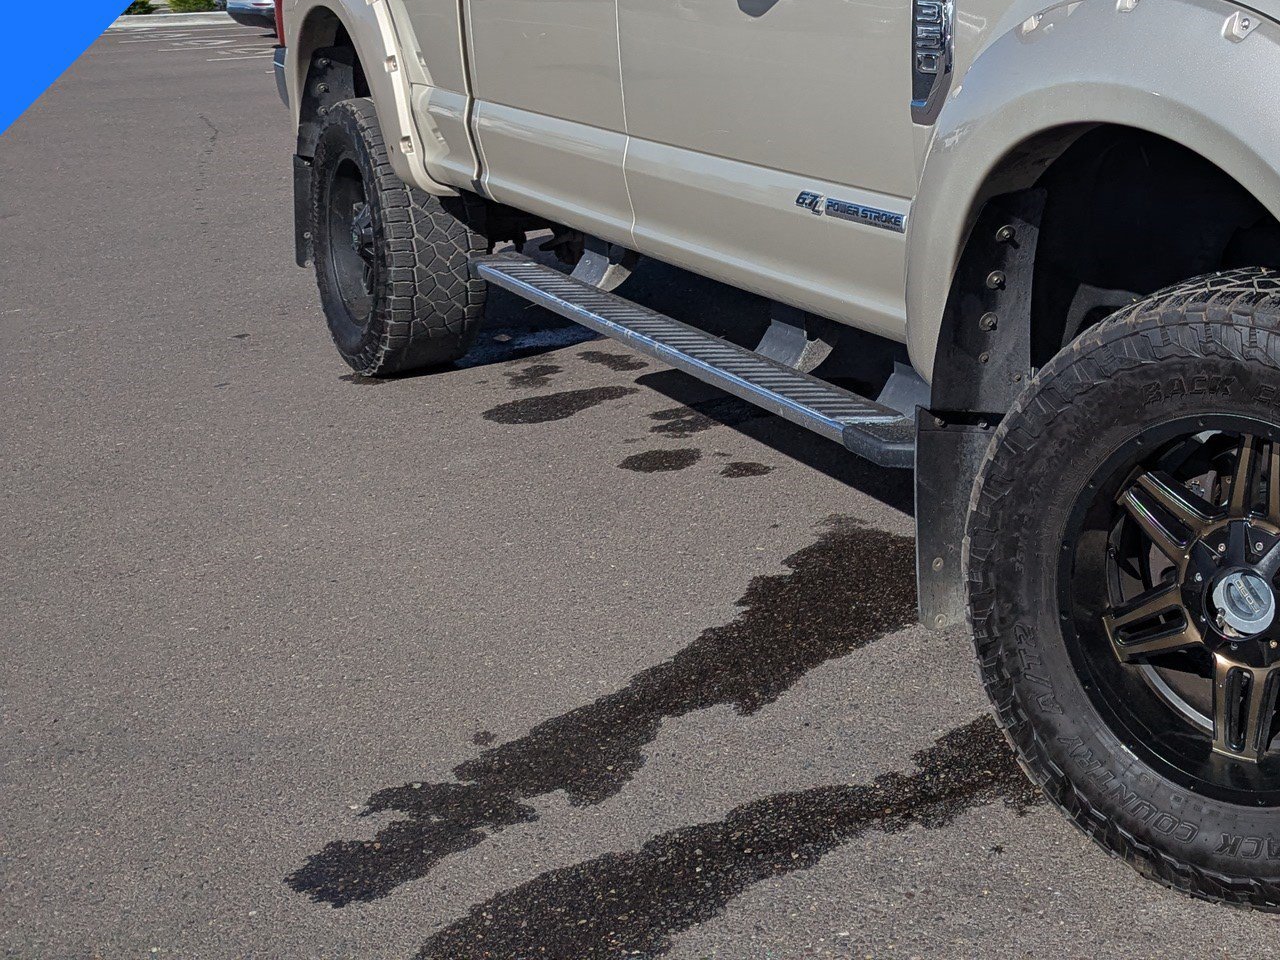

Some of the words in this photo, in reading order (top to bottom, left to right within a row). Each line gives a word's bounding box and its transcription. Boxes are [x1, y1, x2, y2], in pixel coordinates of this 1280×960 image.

[826, 200, 860, 217] POWER
[860, 208, 902, 227] STROKE
[1141, 373, 1238, 407] BACK
[1057, 734, 1200, 845] COUNTRY
